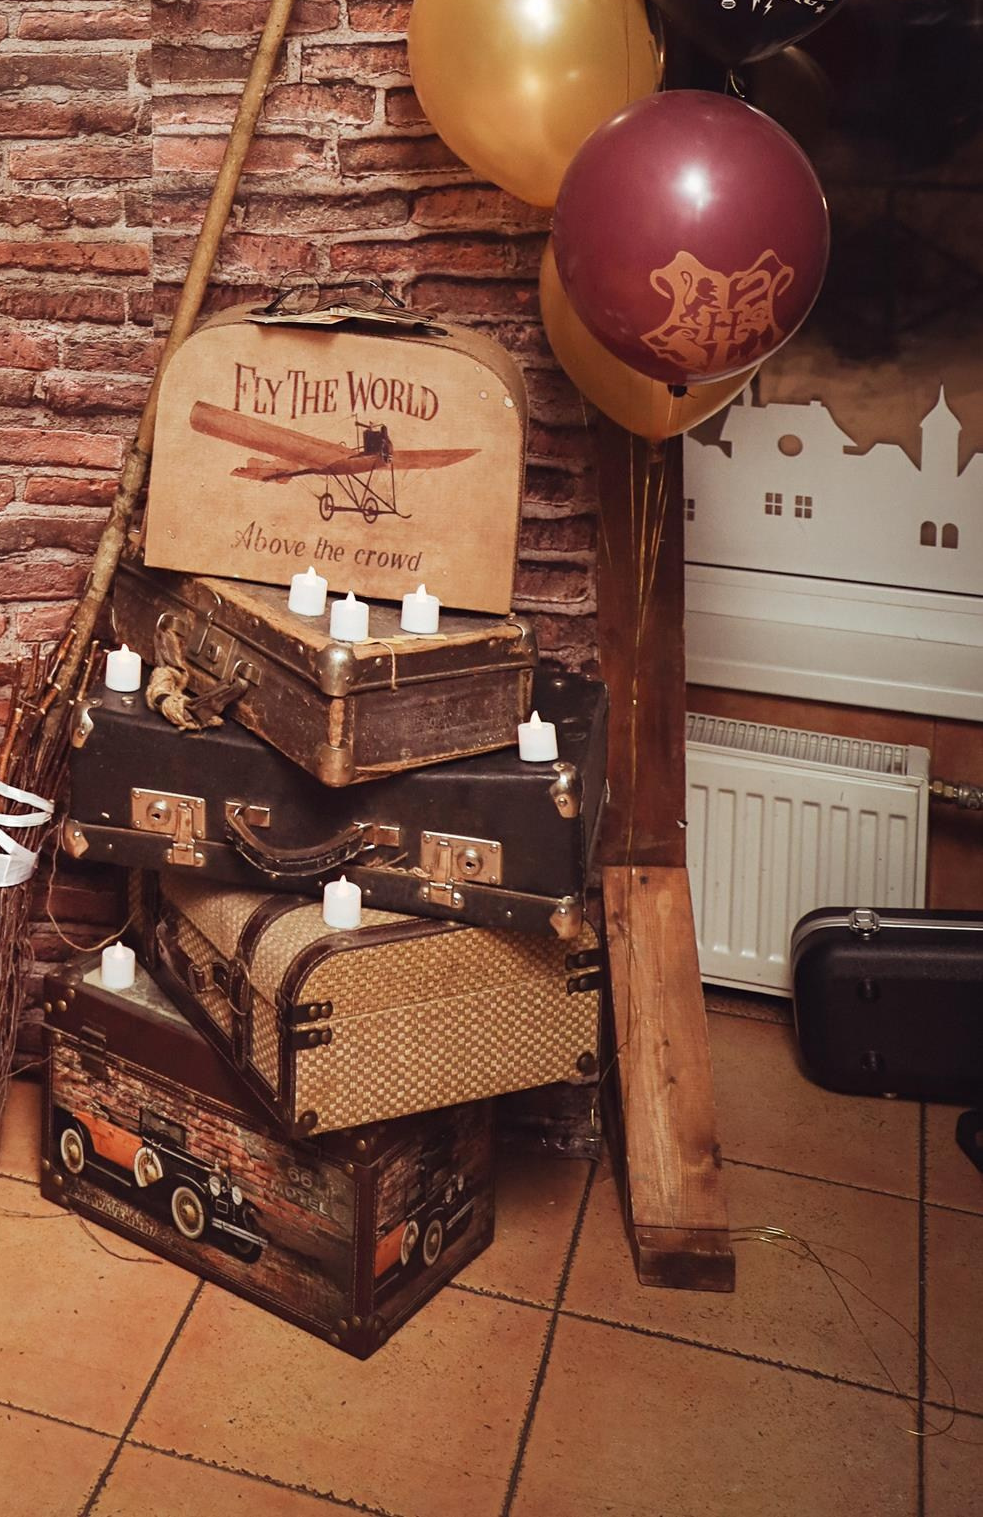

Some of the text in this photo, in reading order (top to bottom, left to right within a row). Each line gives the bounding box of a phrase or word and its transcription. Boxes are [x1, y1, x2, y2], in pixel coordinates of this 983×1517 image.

[232, 362, 440, 421] FLY THE WORLD
[230, 520, 423, 572] Above the crowd
[288, 1166, 314, 1189] 66
